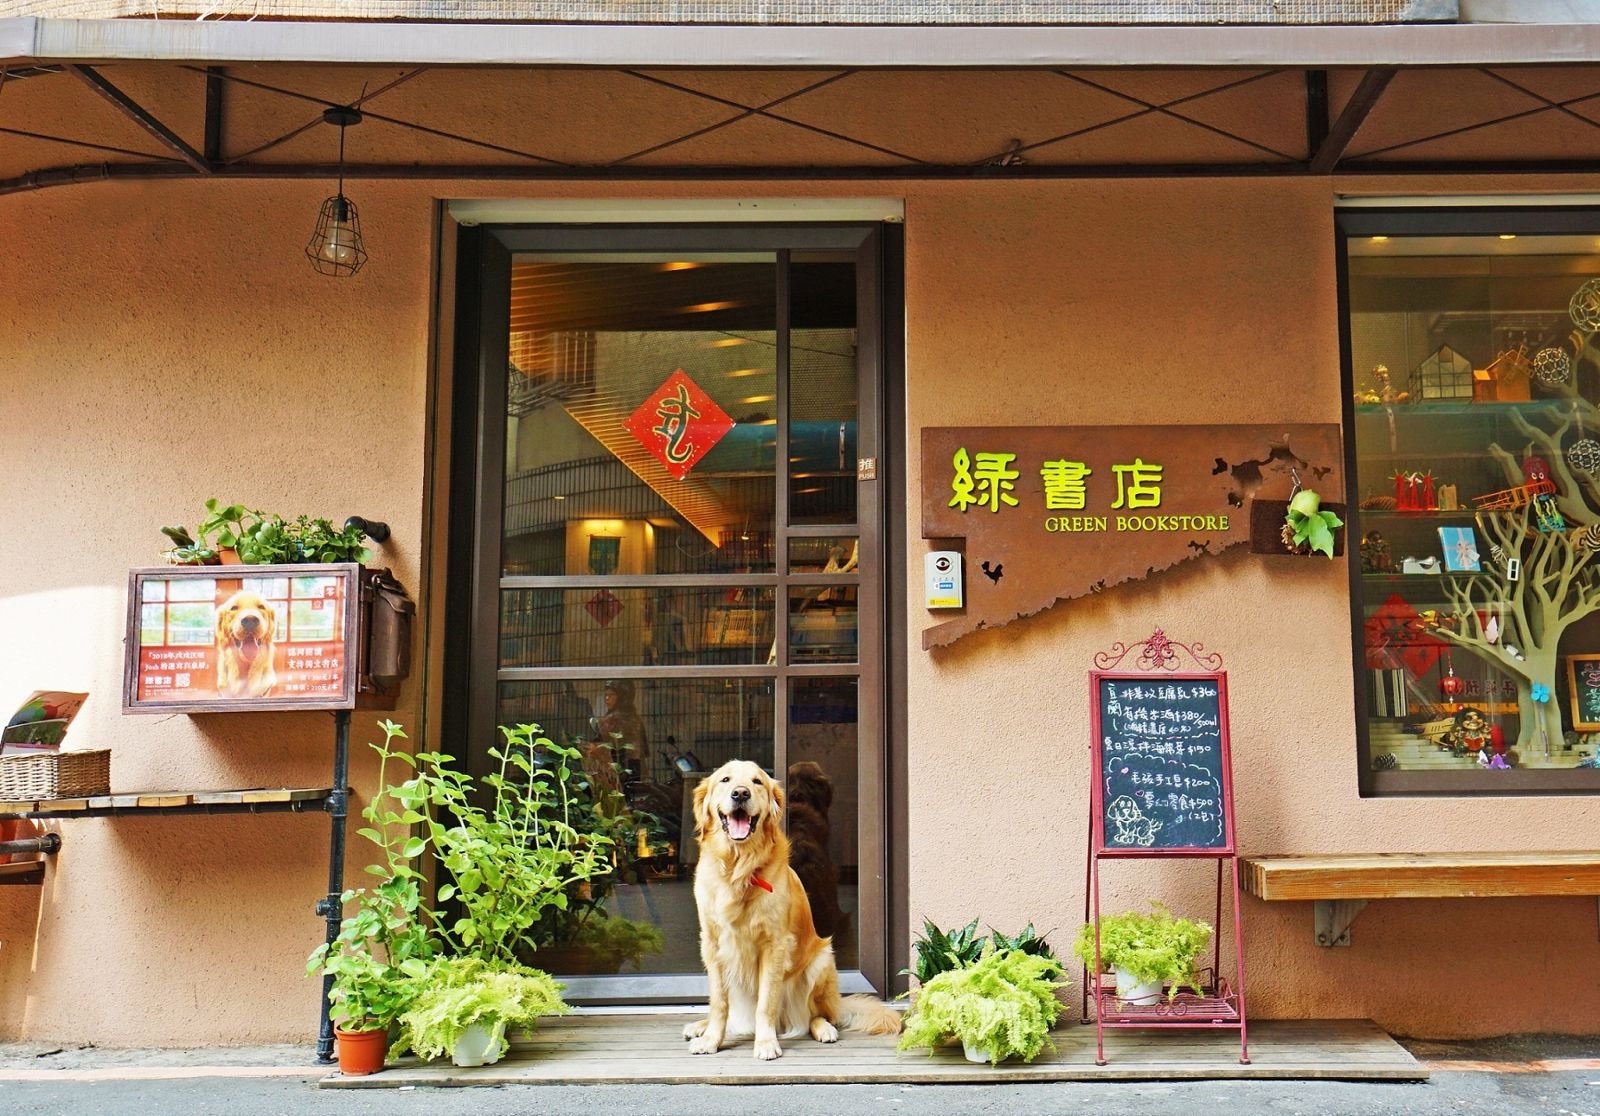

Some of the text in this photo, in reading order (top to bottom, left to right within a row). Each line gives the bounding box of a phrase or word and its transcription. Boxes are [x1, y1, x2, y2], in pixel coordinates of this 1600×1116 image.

[859, 458, 875, 471] 推
[1045, 515, 1230, 532] GREEN BOOKSTORE
